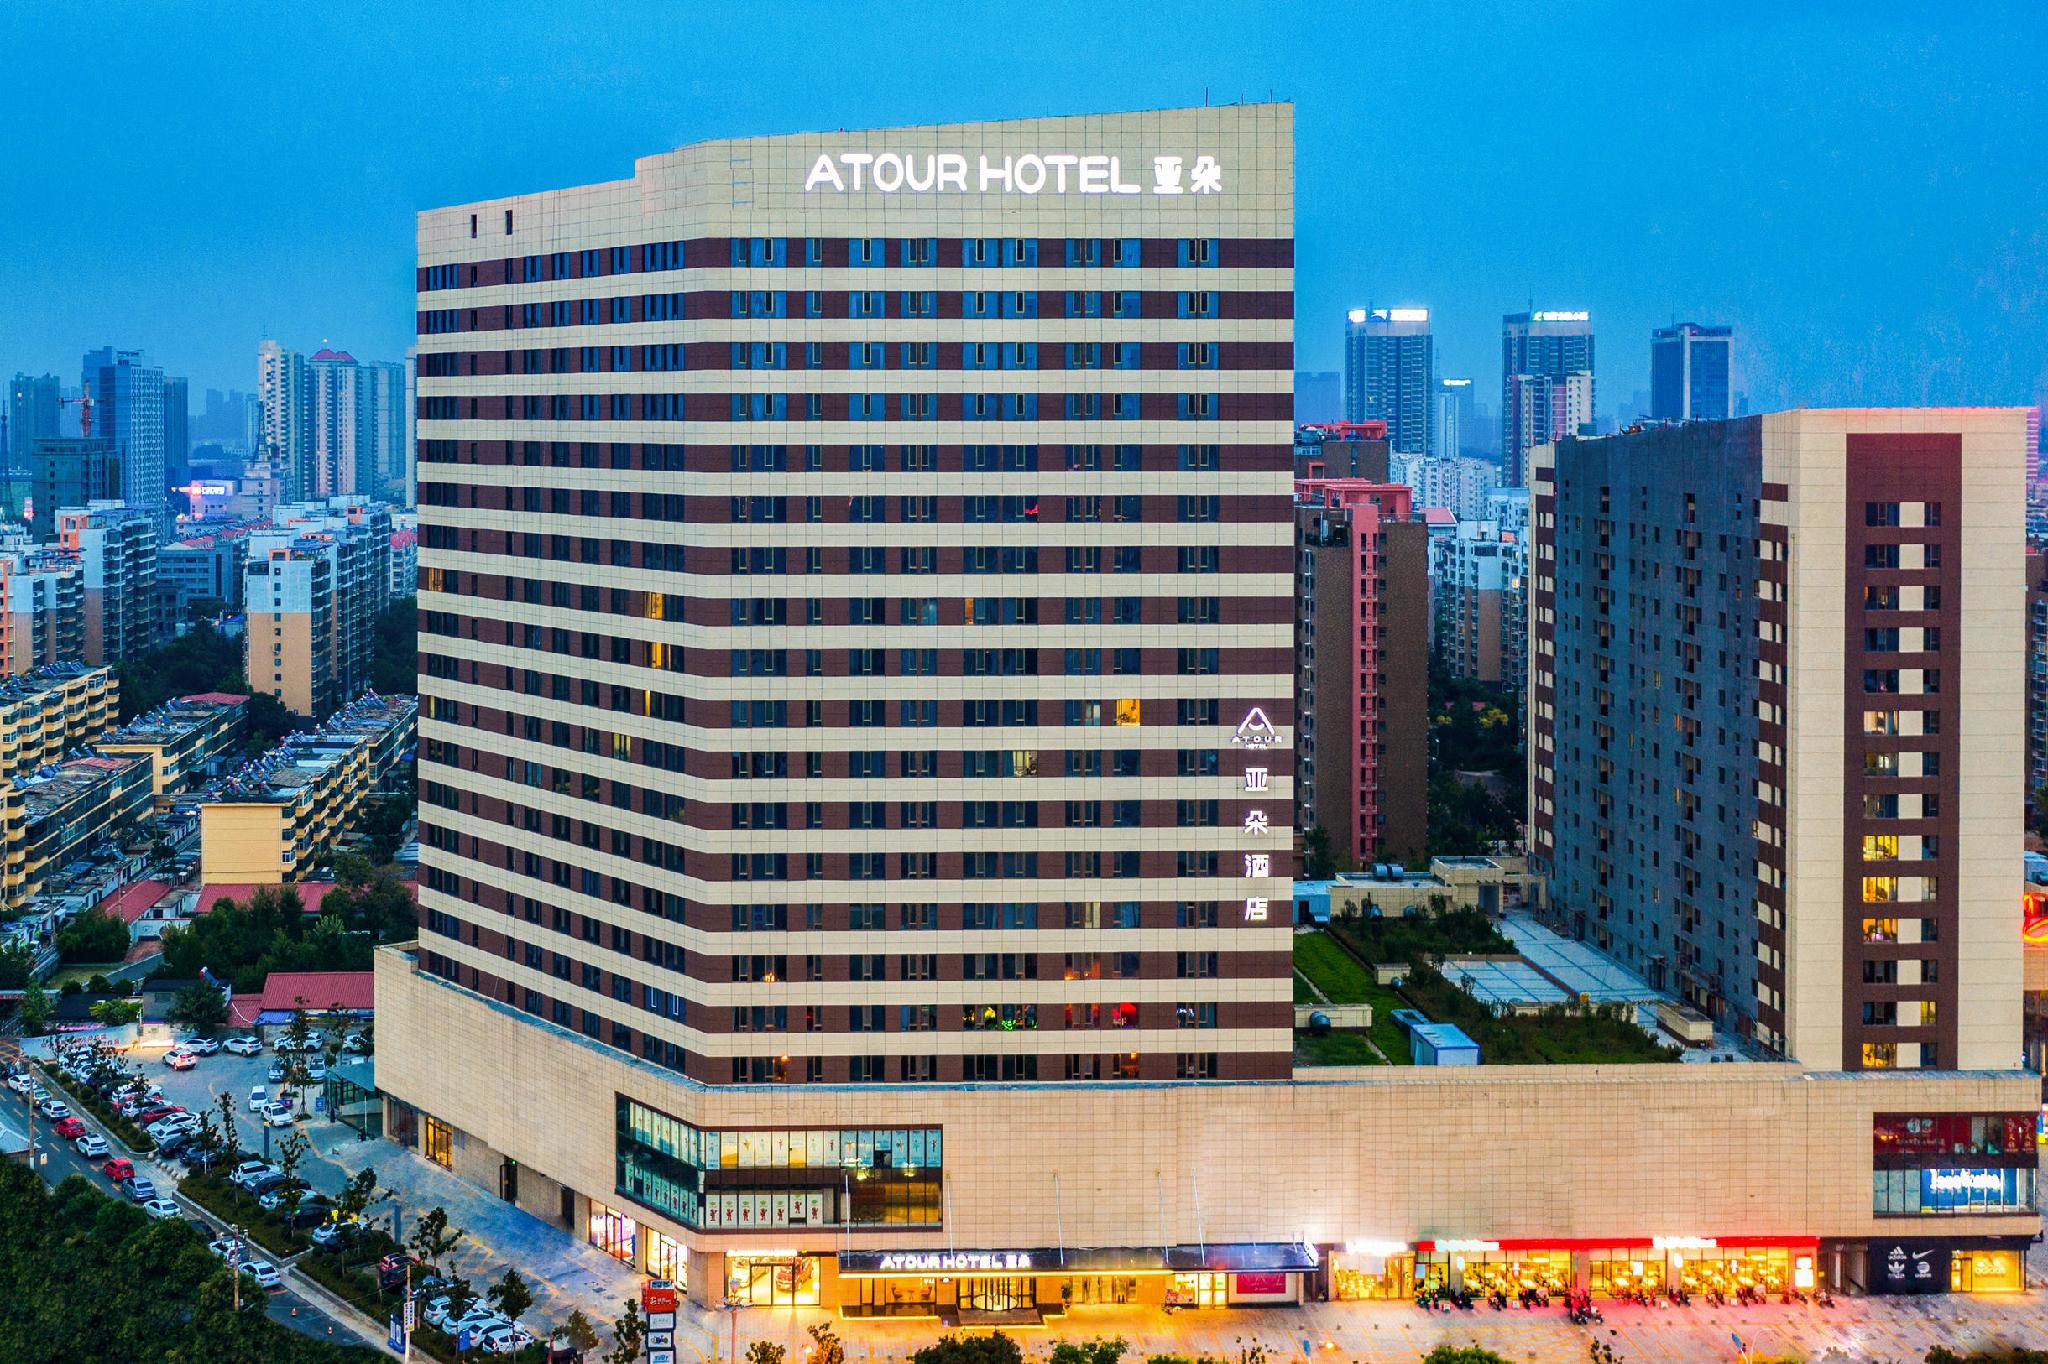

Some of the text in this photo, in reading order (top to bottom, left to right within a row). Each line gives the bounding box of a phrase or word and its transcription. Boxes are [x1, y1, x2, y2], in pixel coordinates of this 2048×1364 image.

[805, 153, 1141, 194] ATOUR HOTEL
[1153, 155, 1222, 194] 亚朵
[1232, 735, 1282, 743] ATOUR
[1244, 767, 1269, 920] 亚朵酒店
[880, 1254, 1003, 1269] ATOUR HOTEL
